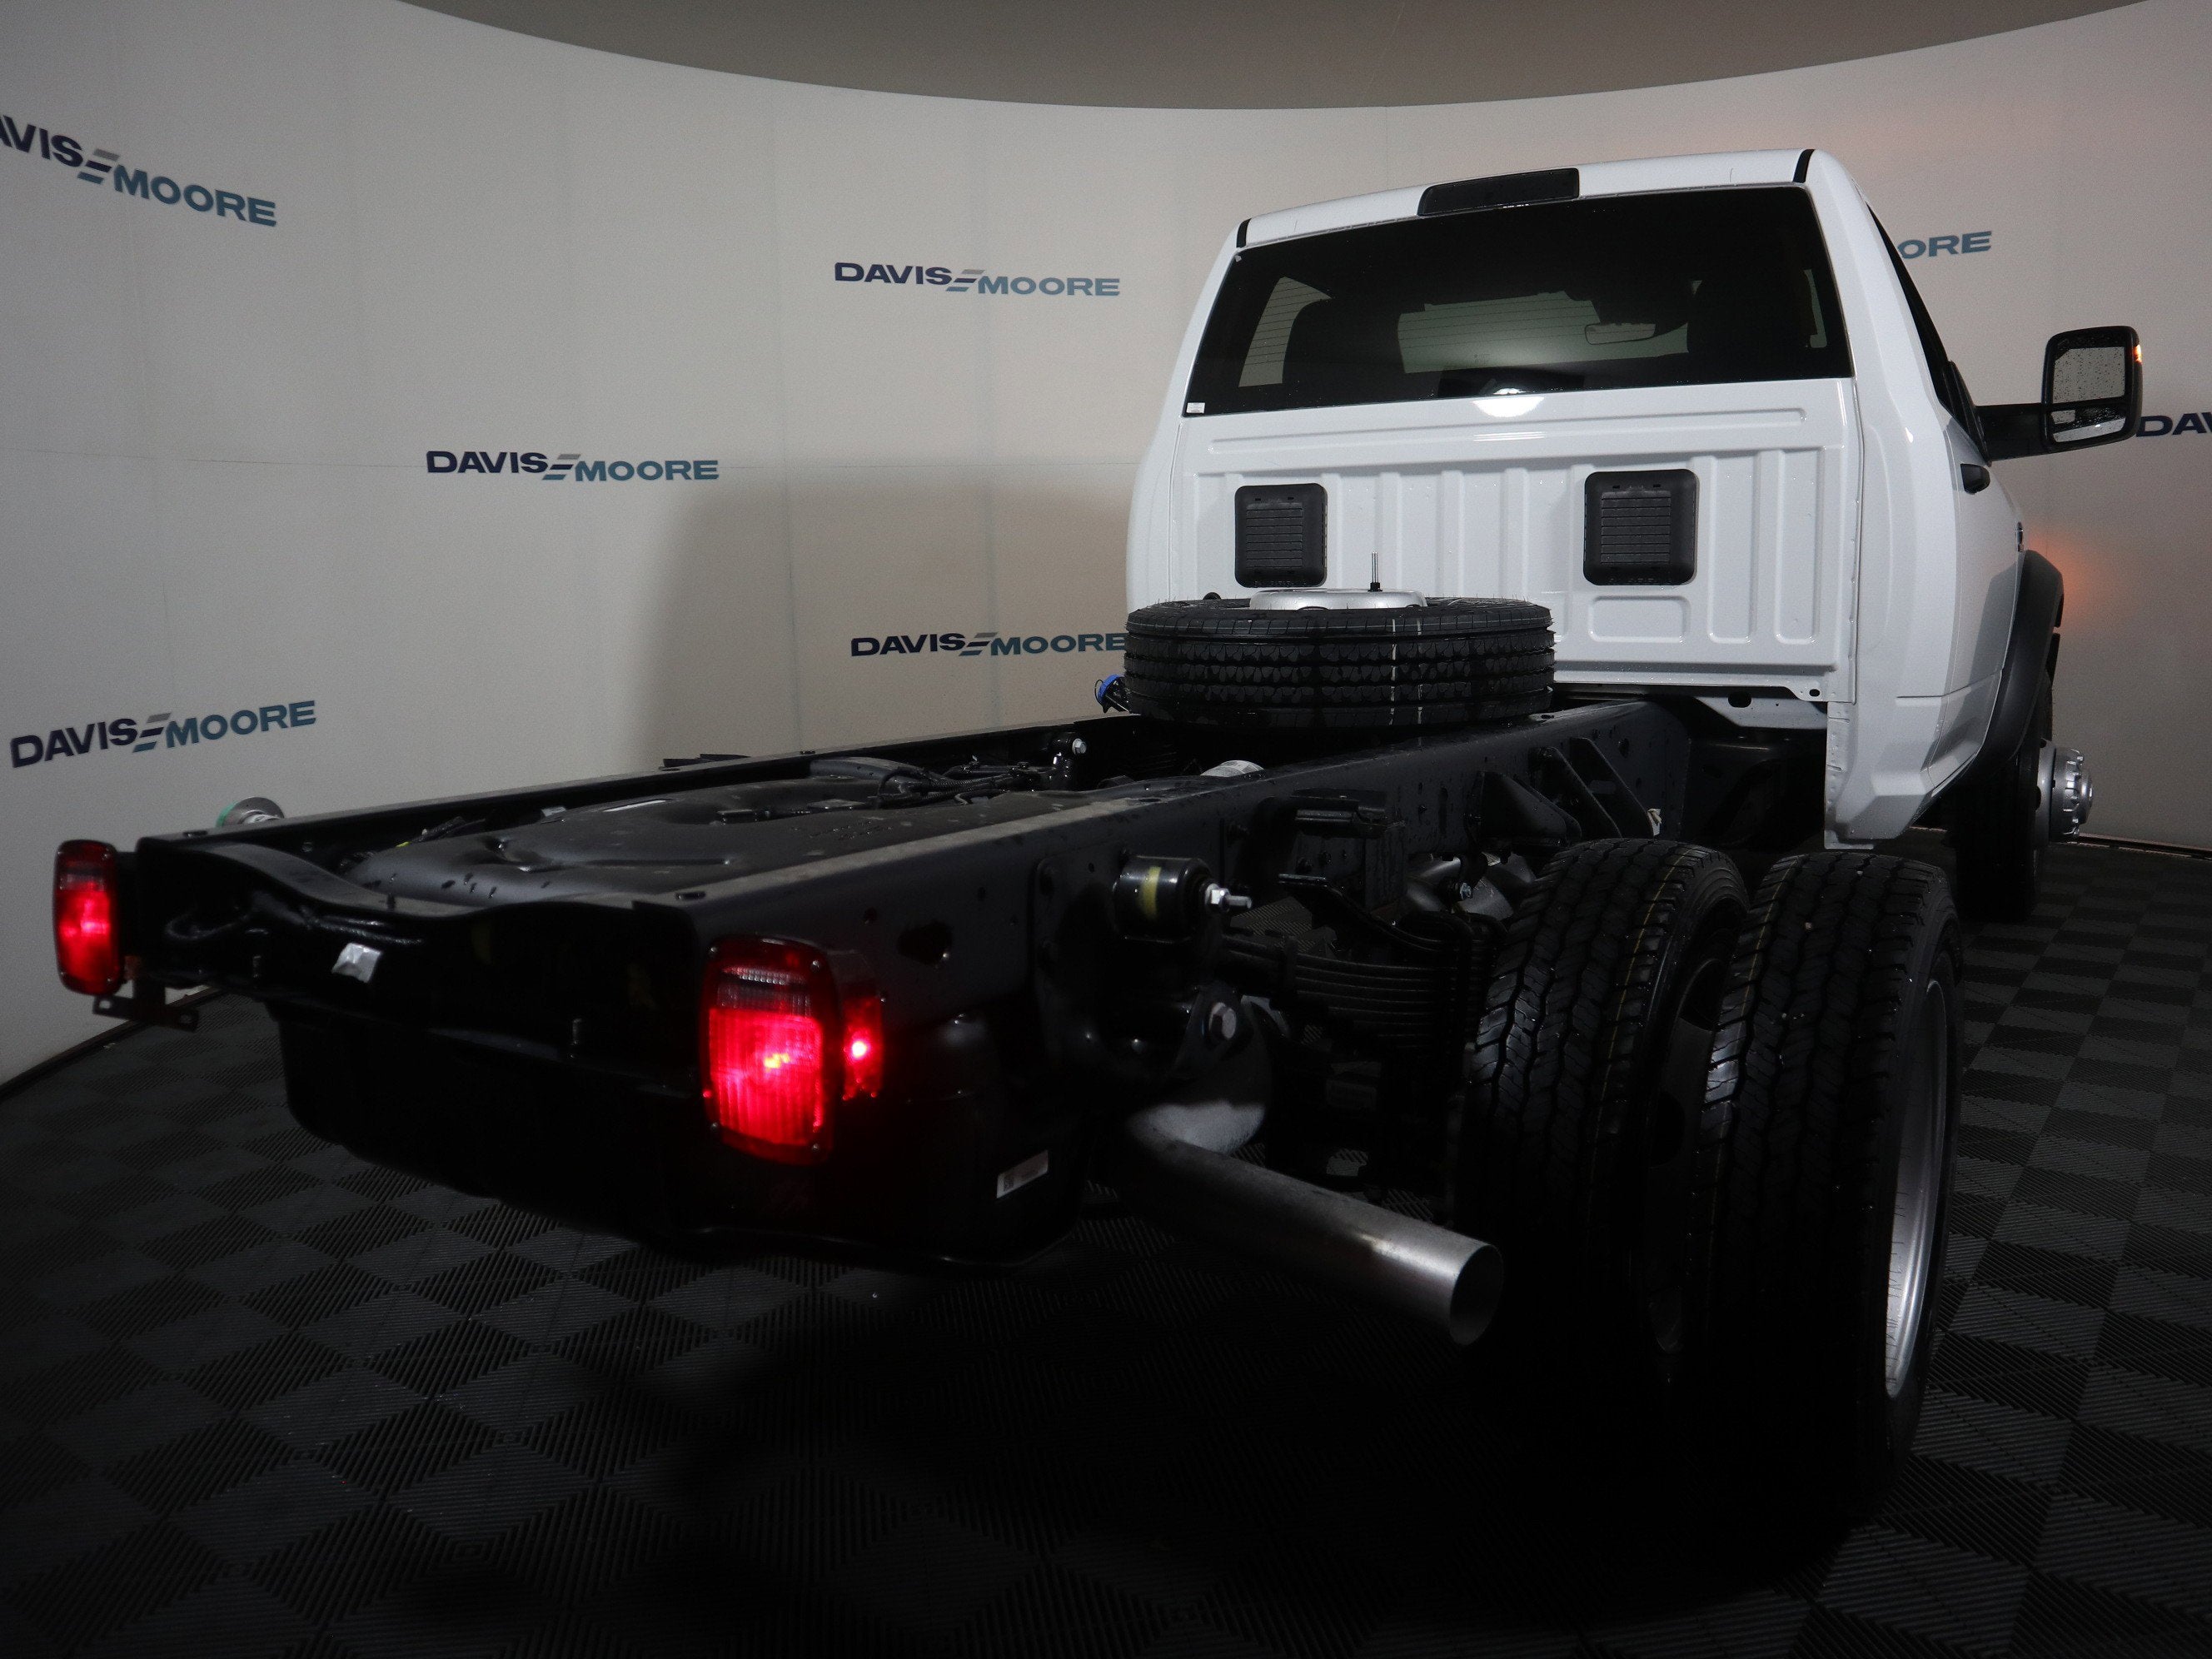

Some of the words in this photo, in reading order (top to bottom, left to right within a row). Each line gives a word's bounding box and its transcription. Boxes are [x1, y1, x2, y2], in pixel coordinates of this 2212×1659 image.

[112, 163, 279, 228] MOORE
[833, 261, 953, 286] DAVIS
[977, 274, 1123, 297] MOORE
[424, 448, 549, 475] DAVIS
[574, 459, 720, 482] MOORE
[849, 631, 966, 657] DAVIS
[989, 631, 1126, 656] MOORE
[8, 716, 138, 770] DAVIS
[165, 700, 317, 750] MOORE
